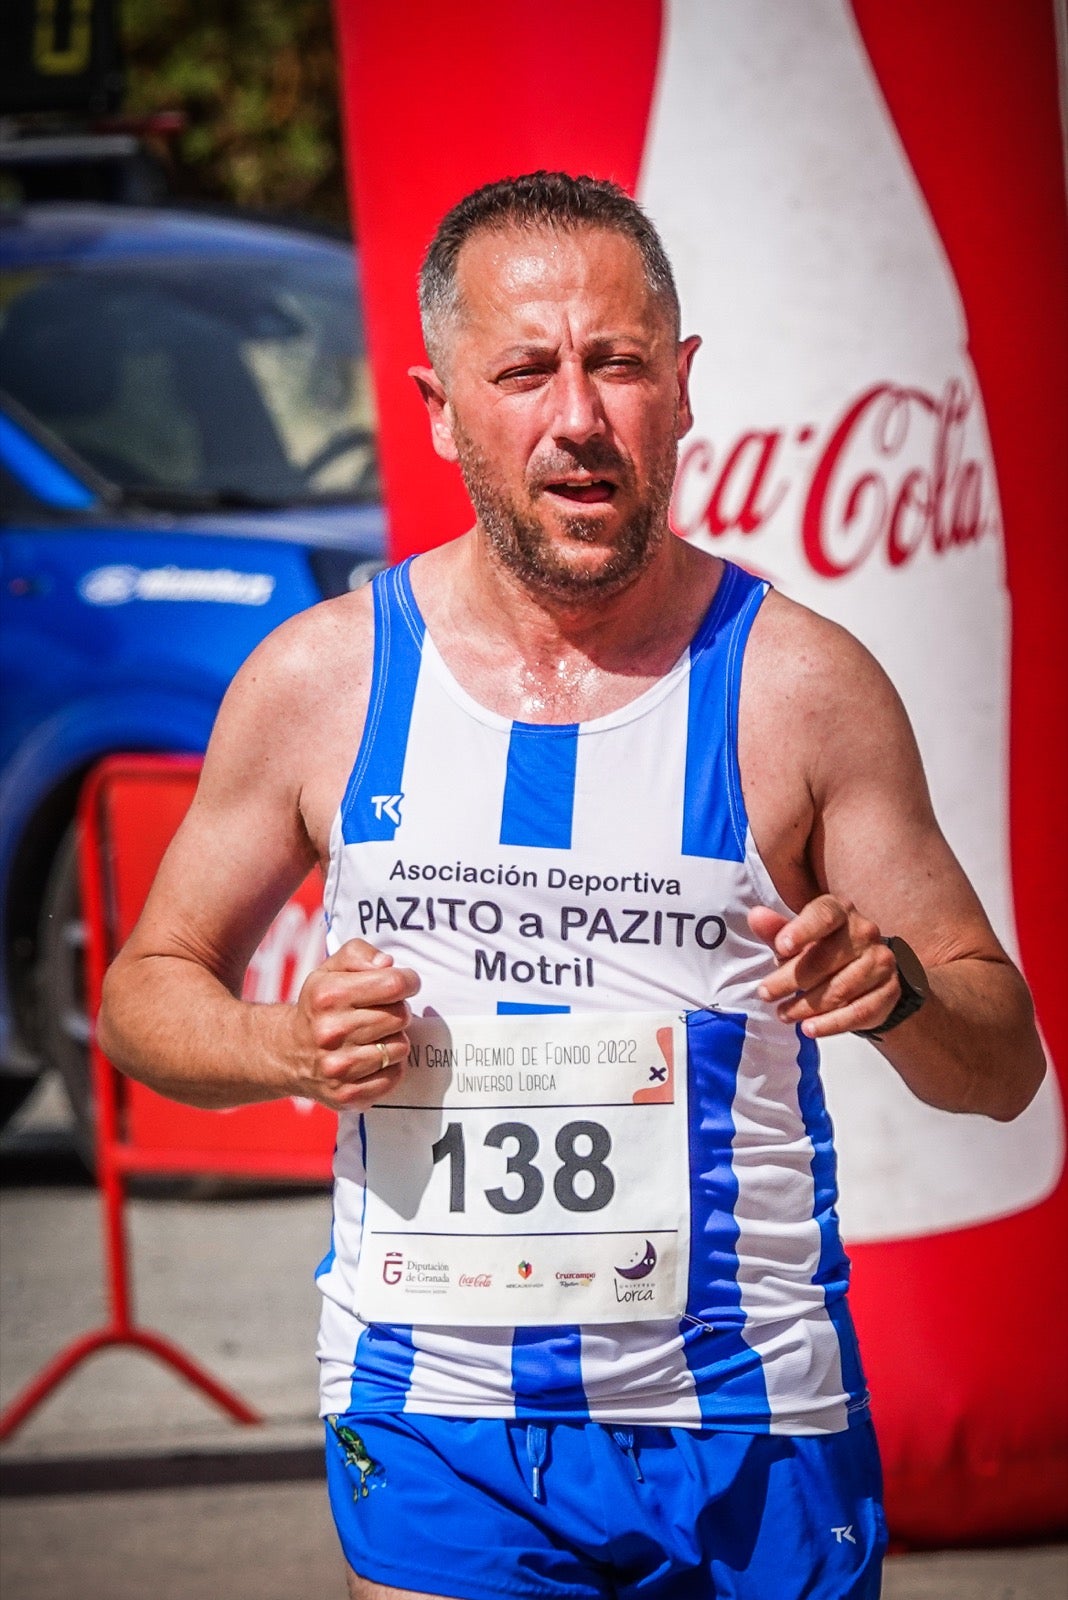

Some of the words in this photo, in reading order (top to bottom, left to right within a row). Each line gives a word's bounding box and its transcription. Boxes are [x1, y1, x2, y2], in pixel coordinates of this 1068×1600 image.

[668, 377, 992, 580] ca-Cola
[389, 859, 537, 888] Asociación
[547, 867, 682, 896] Deportiva
[357, 896, 502, 935] PAZITO
[518, 912, 544, 939] a
[560, 906, 728, 950] PAZITO
[474, 949, 594, 987] Motril
[425, 1044, 458, 1068] GRAN
[465, 1043, 515, 1067] PREMIO
[522, 1046, 538, 1066] DE
[545, 1041, 591, 1066] FONDO
[597, 1039, 638, 1064] 2022
[457, 1073, 513, 1092] UNIVERSO
[519, 1071, 557, 1092] LORCA
[432, 1119, 616, 1216] 138
[405, 1272, 416, 1282] de
[418, 1272, 450, 1283] Granada
[407, 1260, 449, 1272] Diputación
